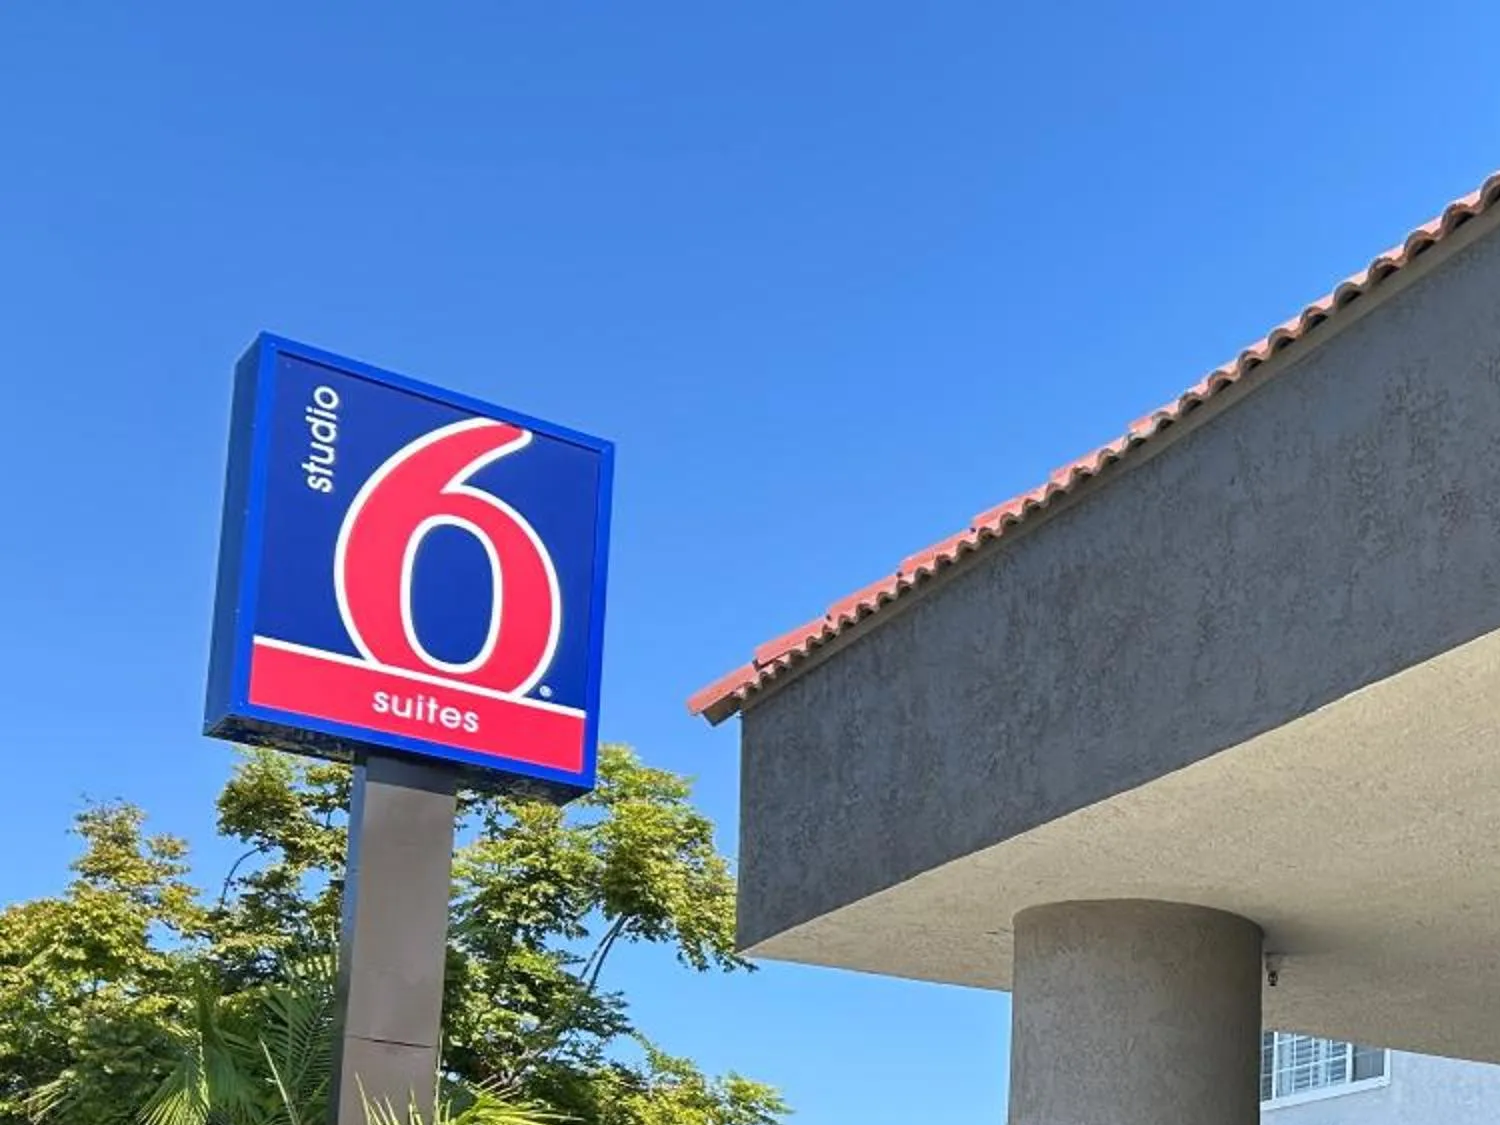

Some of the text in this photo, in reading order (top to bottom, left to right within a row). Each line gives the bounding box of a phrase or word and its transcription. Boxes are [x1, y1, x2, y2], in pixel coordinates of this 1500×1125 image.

[301, 385, 340, 493] studio
[334, 417, 561, 699] 6
[372, 690, 480, 734] suites
